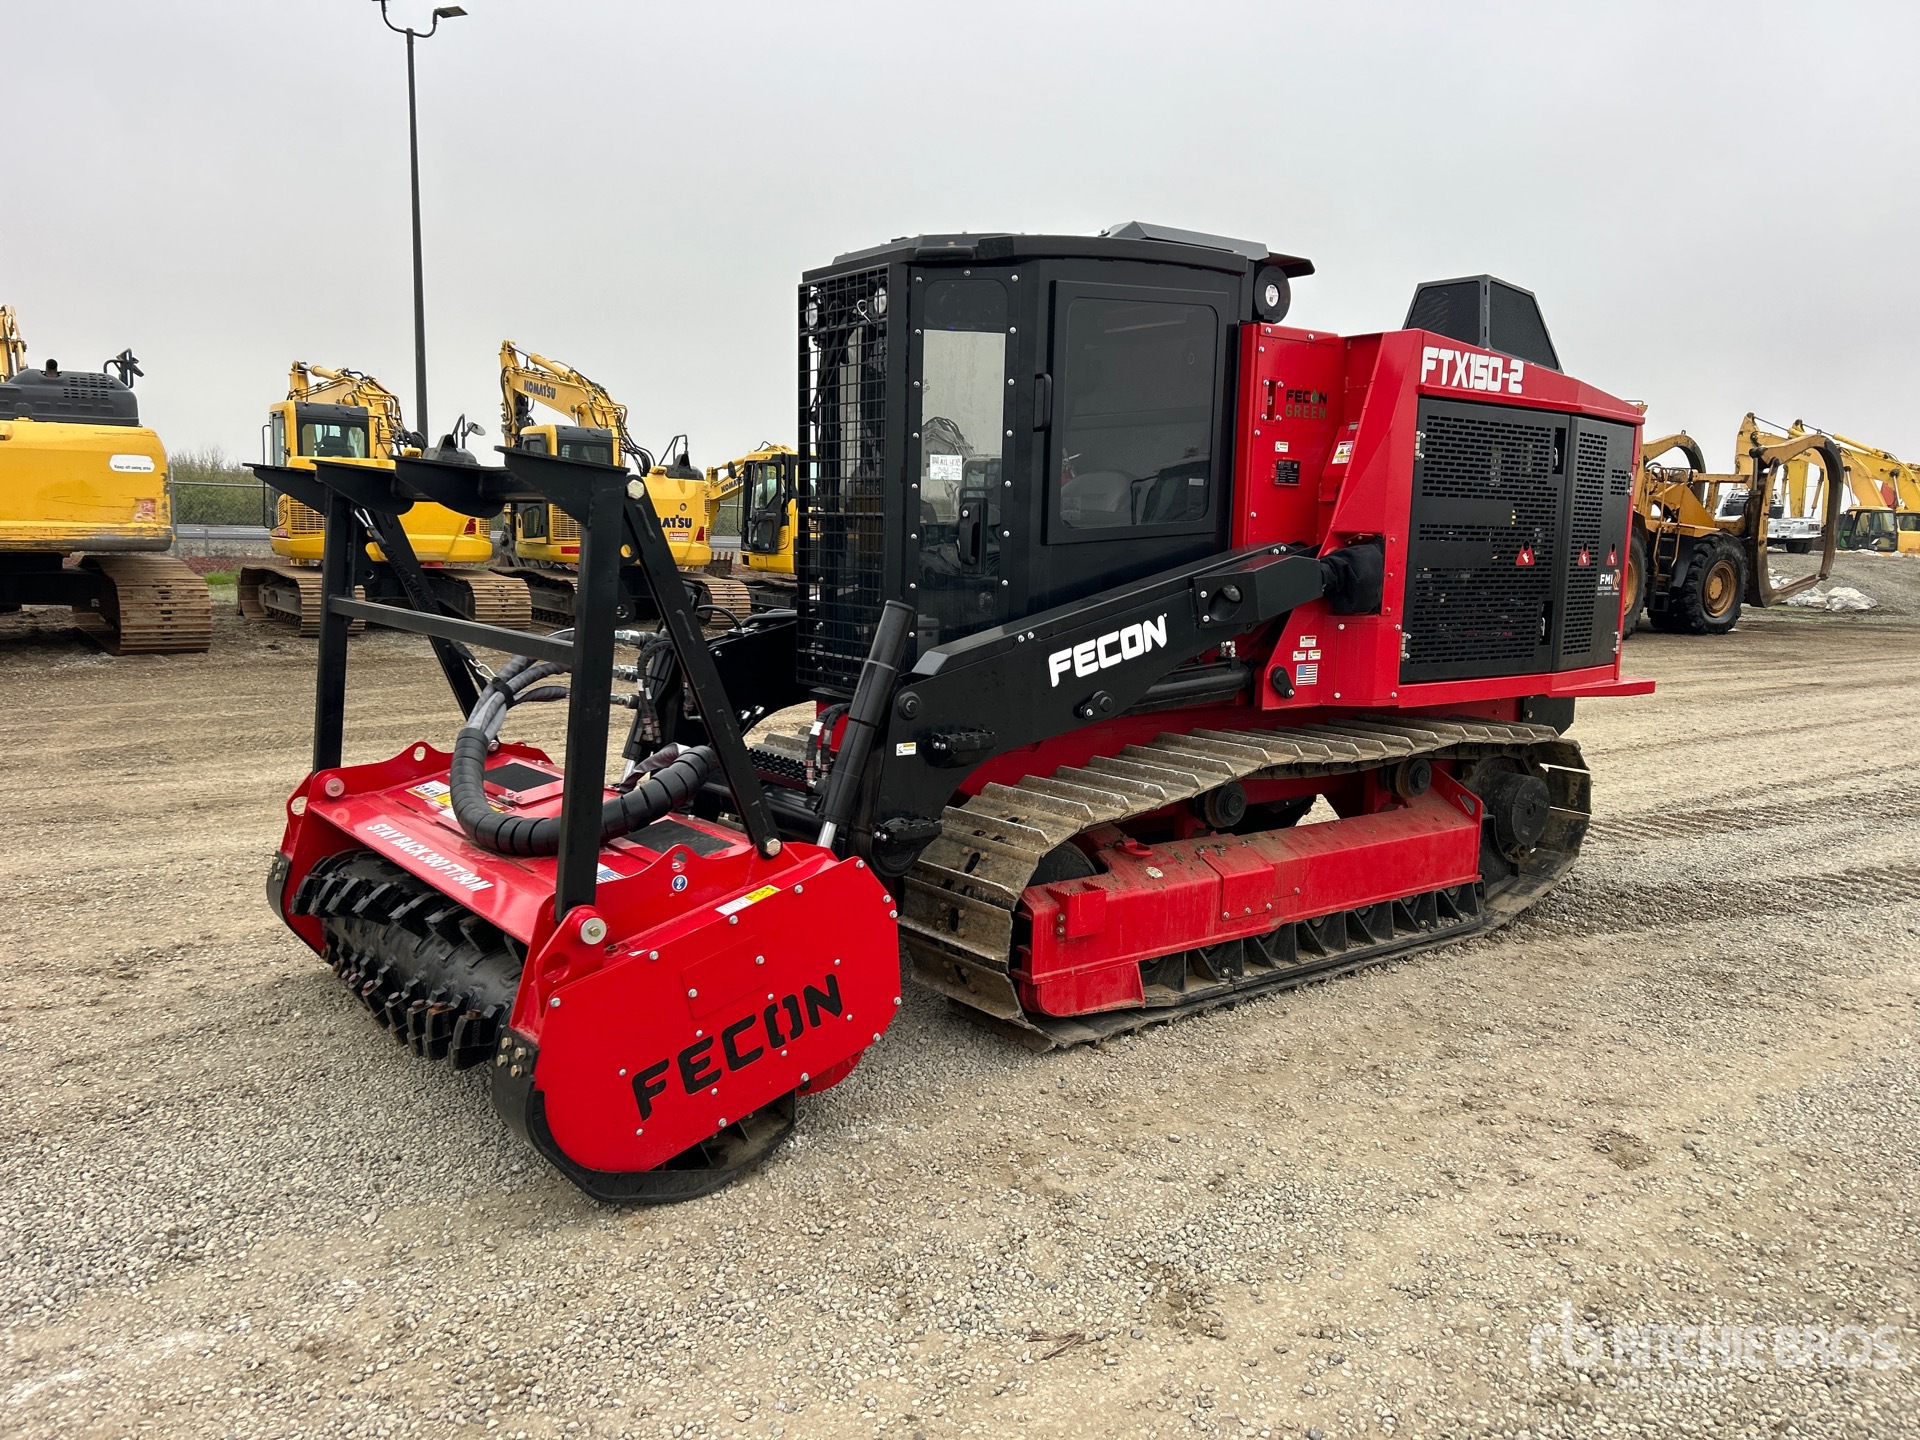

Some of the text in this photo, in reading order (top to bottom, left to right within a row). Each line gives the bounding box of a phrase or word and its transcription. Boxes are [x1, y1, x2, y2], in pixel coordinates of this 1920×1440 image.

[1420, 346, 1524, 394] FTX150-2
[523, 379, 556, 400] KOMATSU
[1285, 403, 1327, 419] GREEN
[1600, 573, 1614, 585] FMI
[1048, 613, 1168, 688] FECON
[366, 823, 406, 840] STAY
[389, 836, 434, 857] BACK
[631, 973, 843, 1122] FECON
